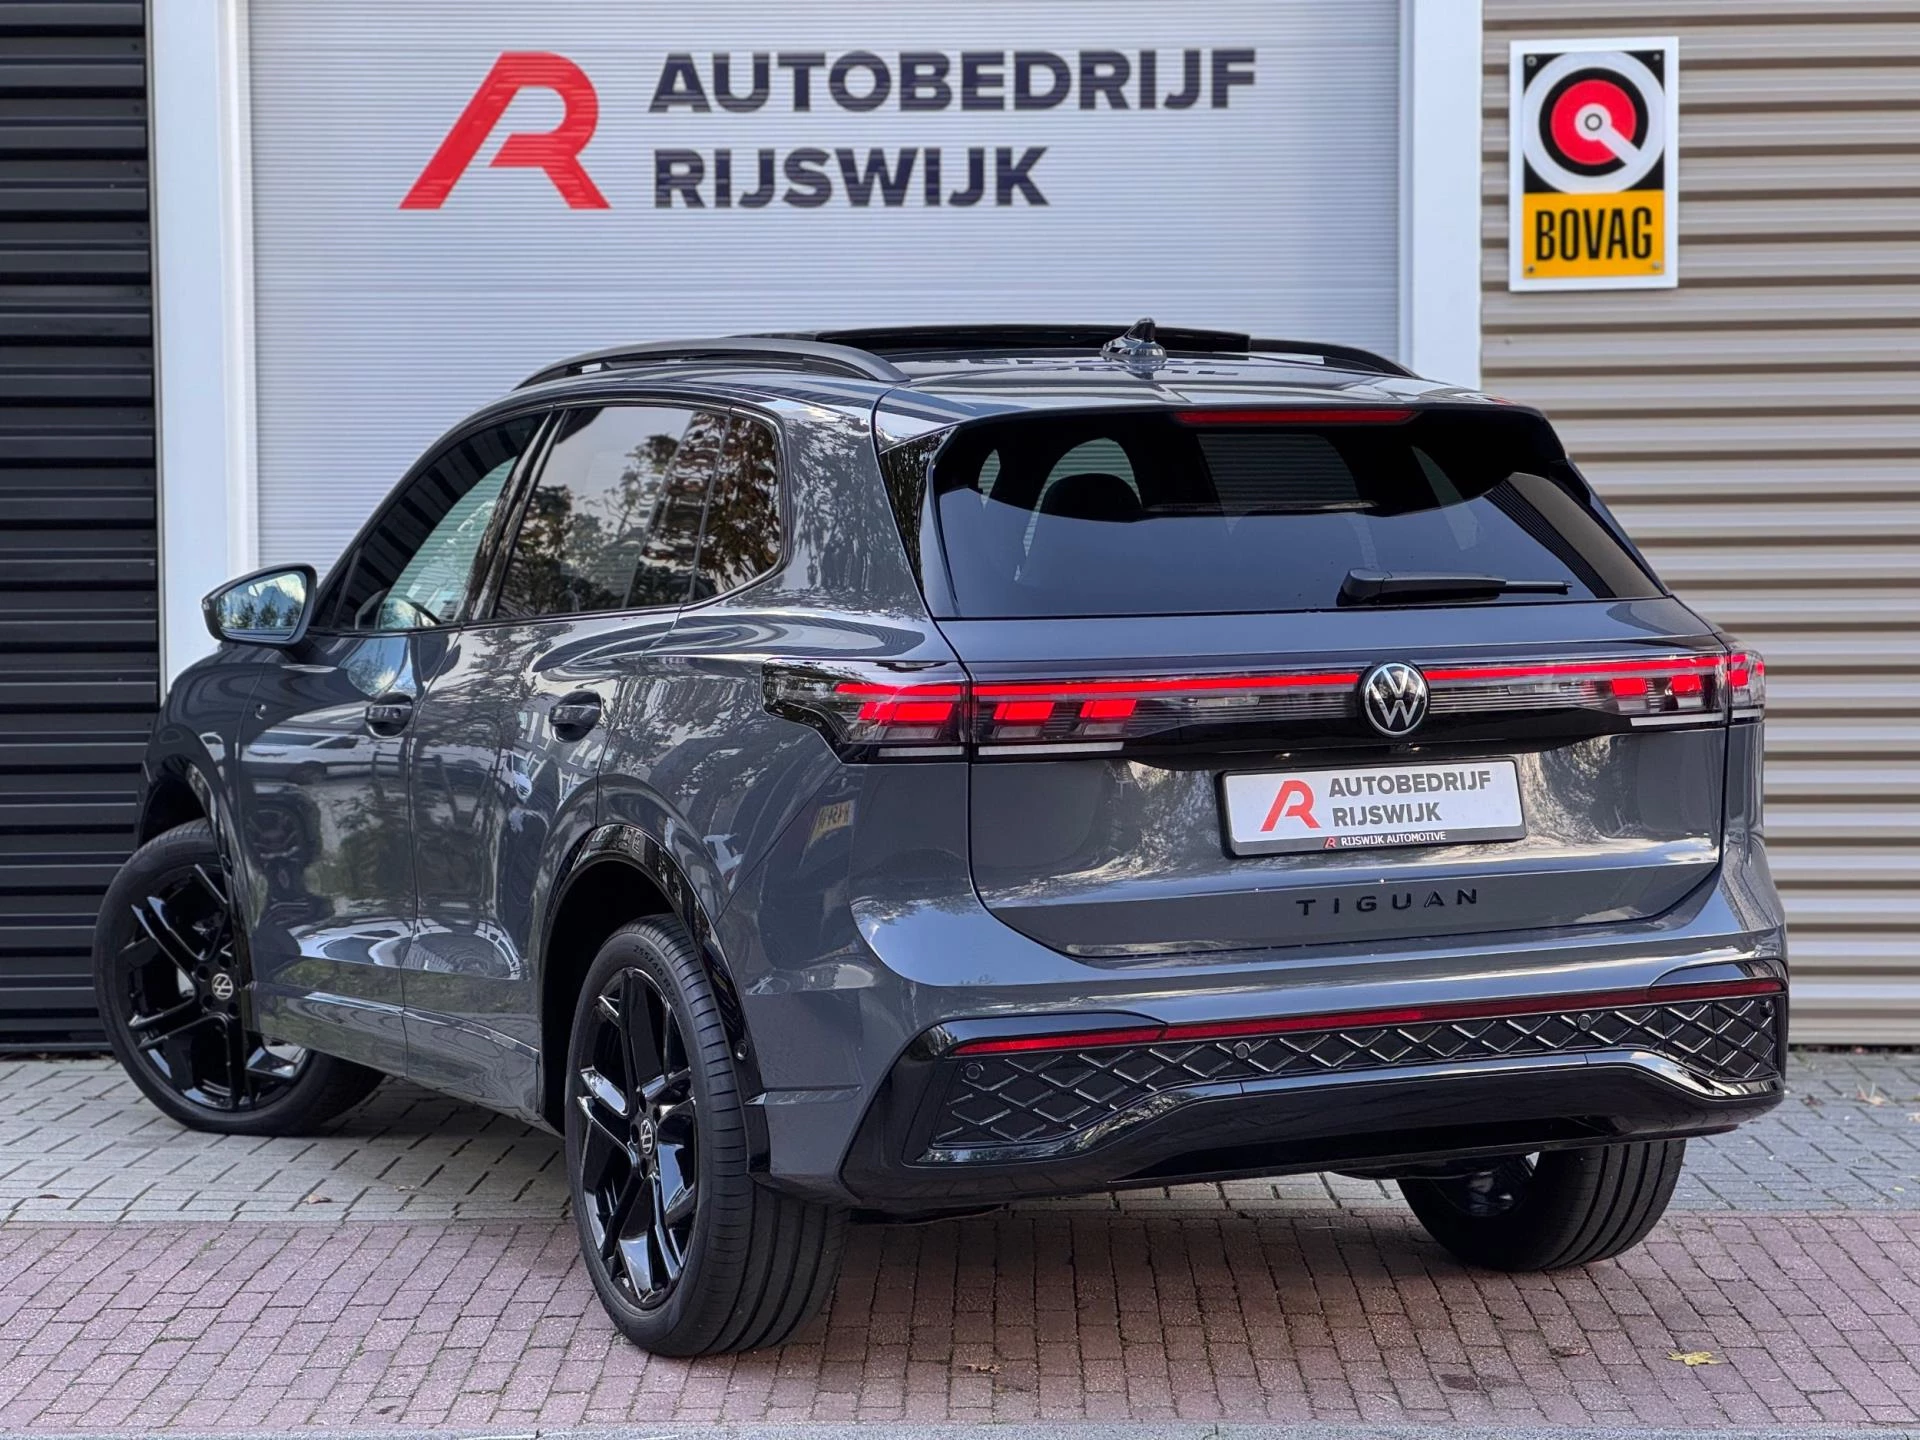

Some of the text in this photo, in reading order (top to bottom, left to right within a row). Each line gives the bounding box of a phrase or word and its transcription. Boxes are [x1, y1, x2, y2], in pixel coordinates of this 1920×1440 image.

[648, 47, 1257, 114] AUTOBEDRIJF
[653, 147, 1050, 209] RIJSWIJK
[1536, 207, 1653, 261] BOVAG
[1329, 770, 1491, 798] AUTOBEDRIJF
[1332, 802, 1442, 827] RIJSWIJK
[1341, 831, 1447, 846] RIJSWIJK AUTOMOTIVE
[1295, 888, 1478, 916] TIGUAN
